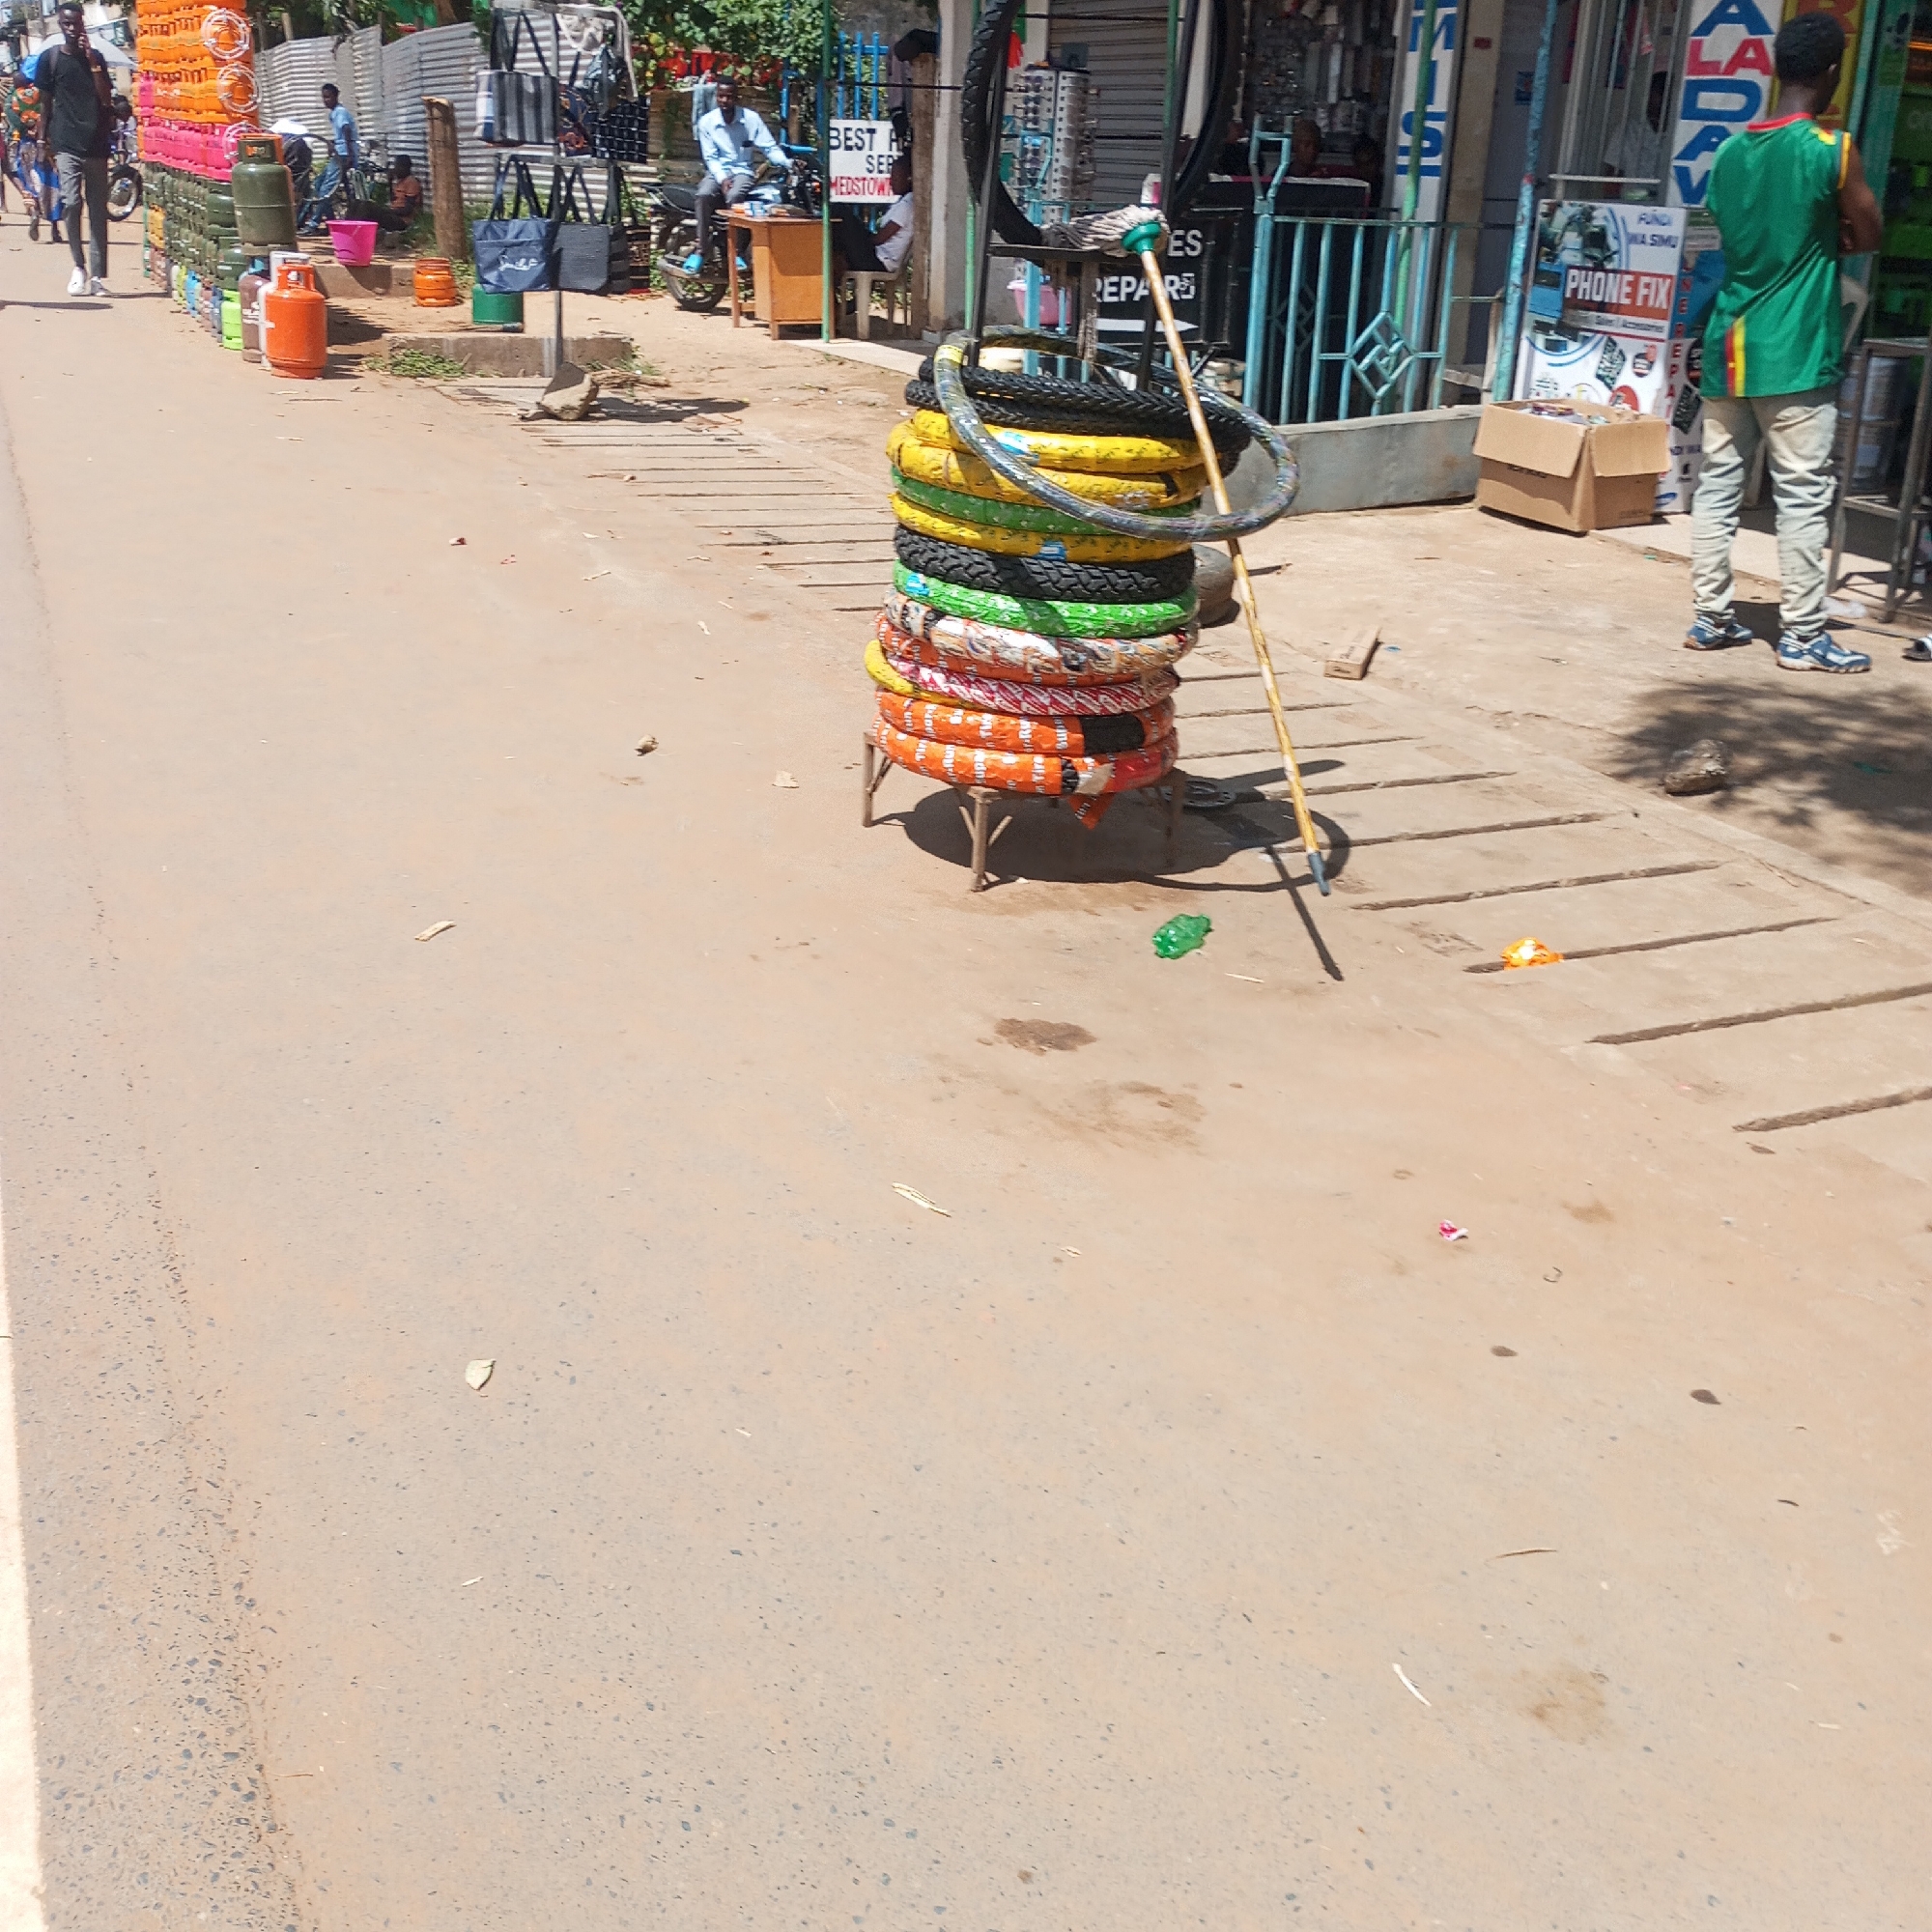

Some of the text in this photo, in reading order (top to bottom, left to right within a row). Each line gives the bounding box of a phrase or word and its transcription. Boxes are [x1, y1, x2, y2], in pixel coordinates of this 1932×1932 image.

[830, 127, 877, 151] BEST
[1565, 270, 1672, 309] PHONE FIX
